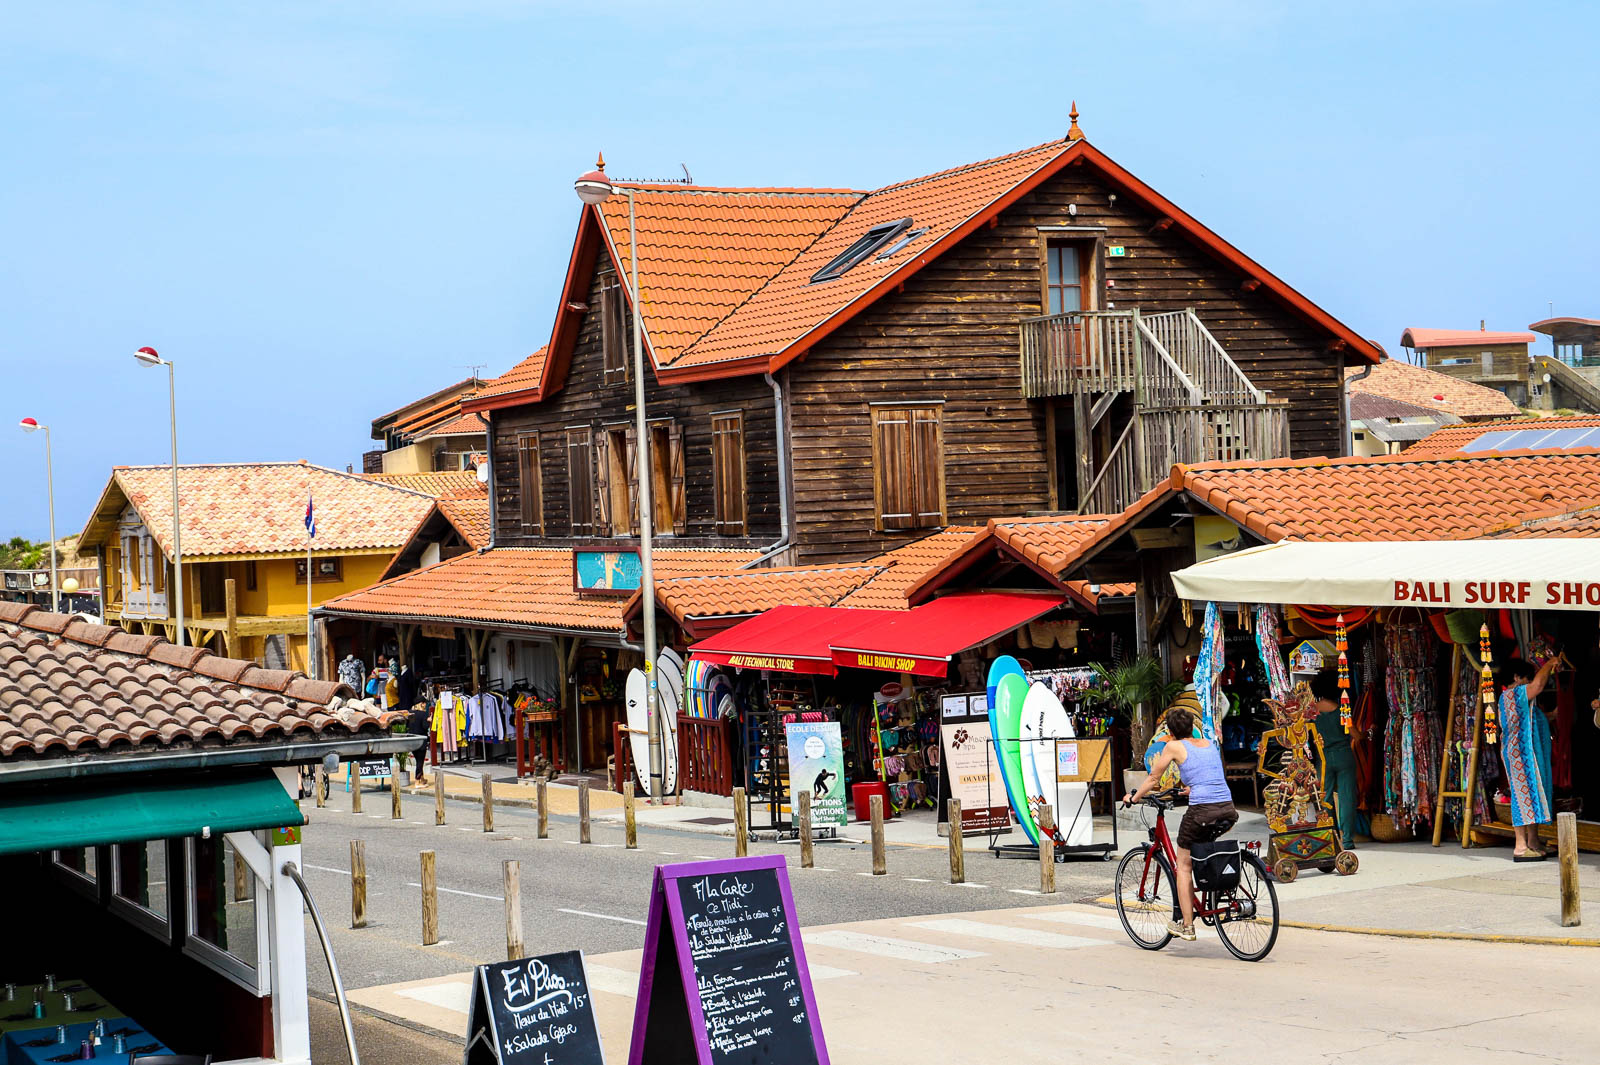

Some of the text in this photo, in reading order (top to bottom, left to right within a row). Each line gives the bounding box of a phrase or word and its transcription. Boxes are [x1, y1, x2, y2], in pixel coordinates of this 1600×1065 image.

[1394, 581, 1451, 602] BALI
[1465, 582, 1531, 603] SURF
[728, 655, 795, 670] BALI TECHNICAL STORE
[857, 654, 916, 671] BALI BIKINI SHOP
[704, 934, 726, 946] Salade
[513, 1012, 538, 1029] Menu
[537, 1008, 551, 1021] du
[547, 1000, 569, 1018] Midi
[512, 1030, 550, 1053] Salade
